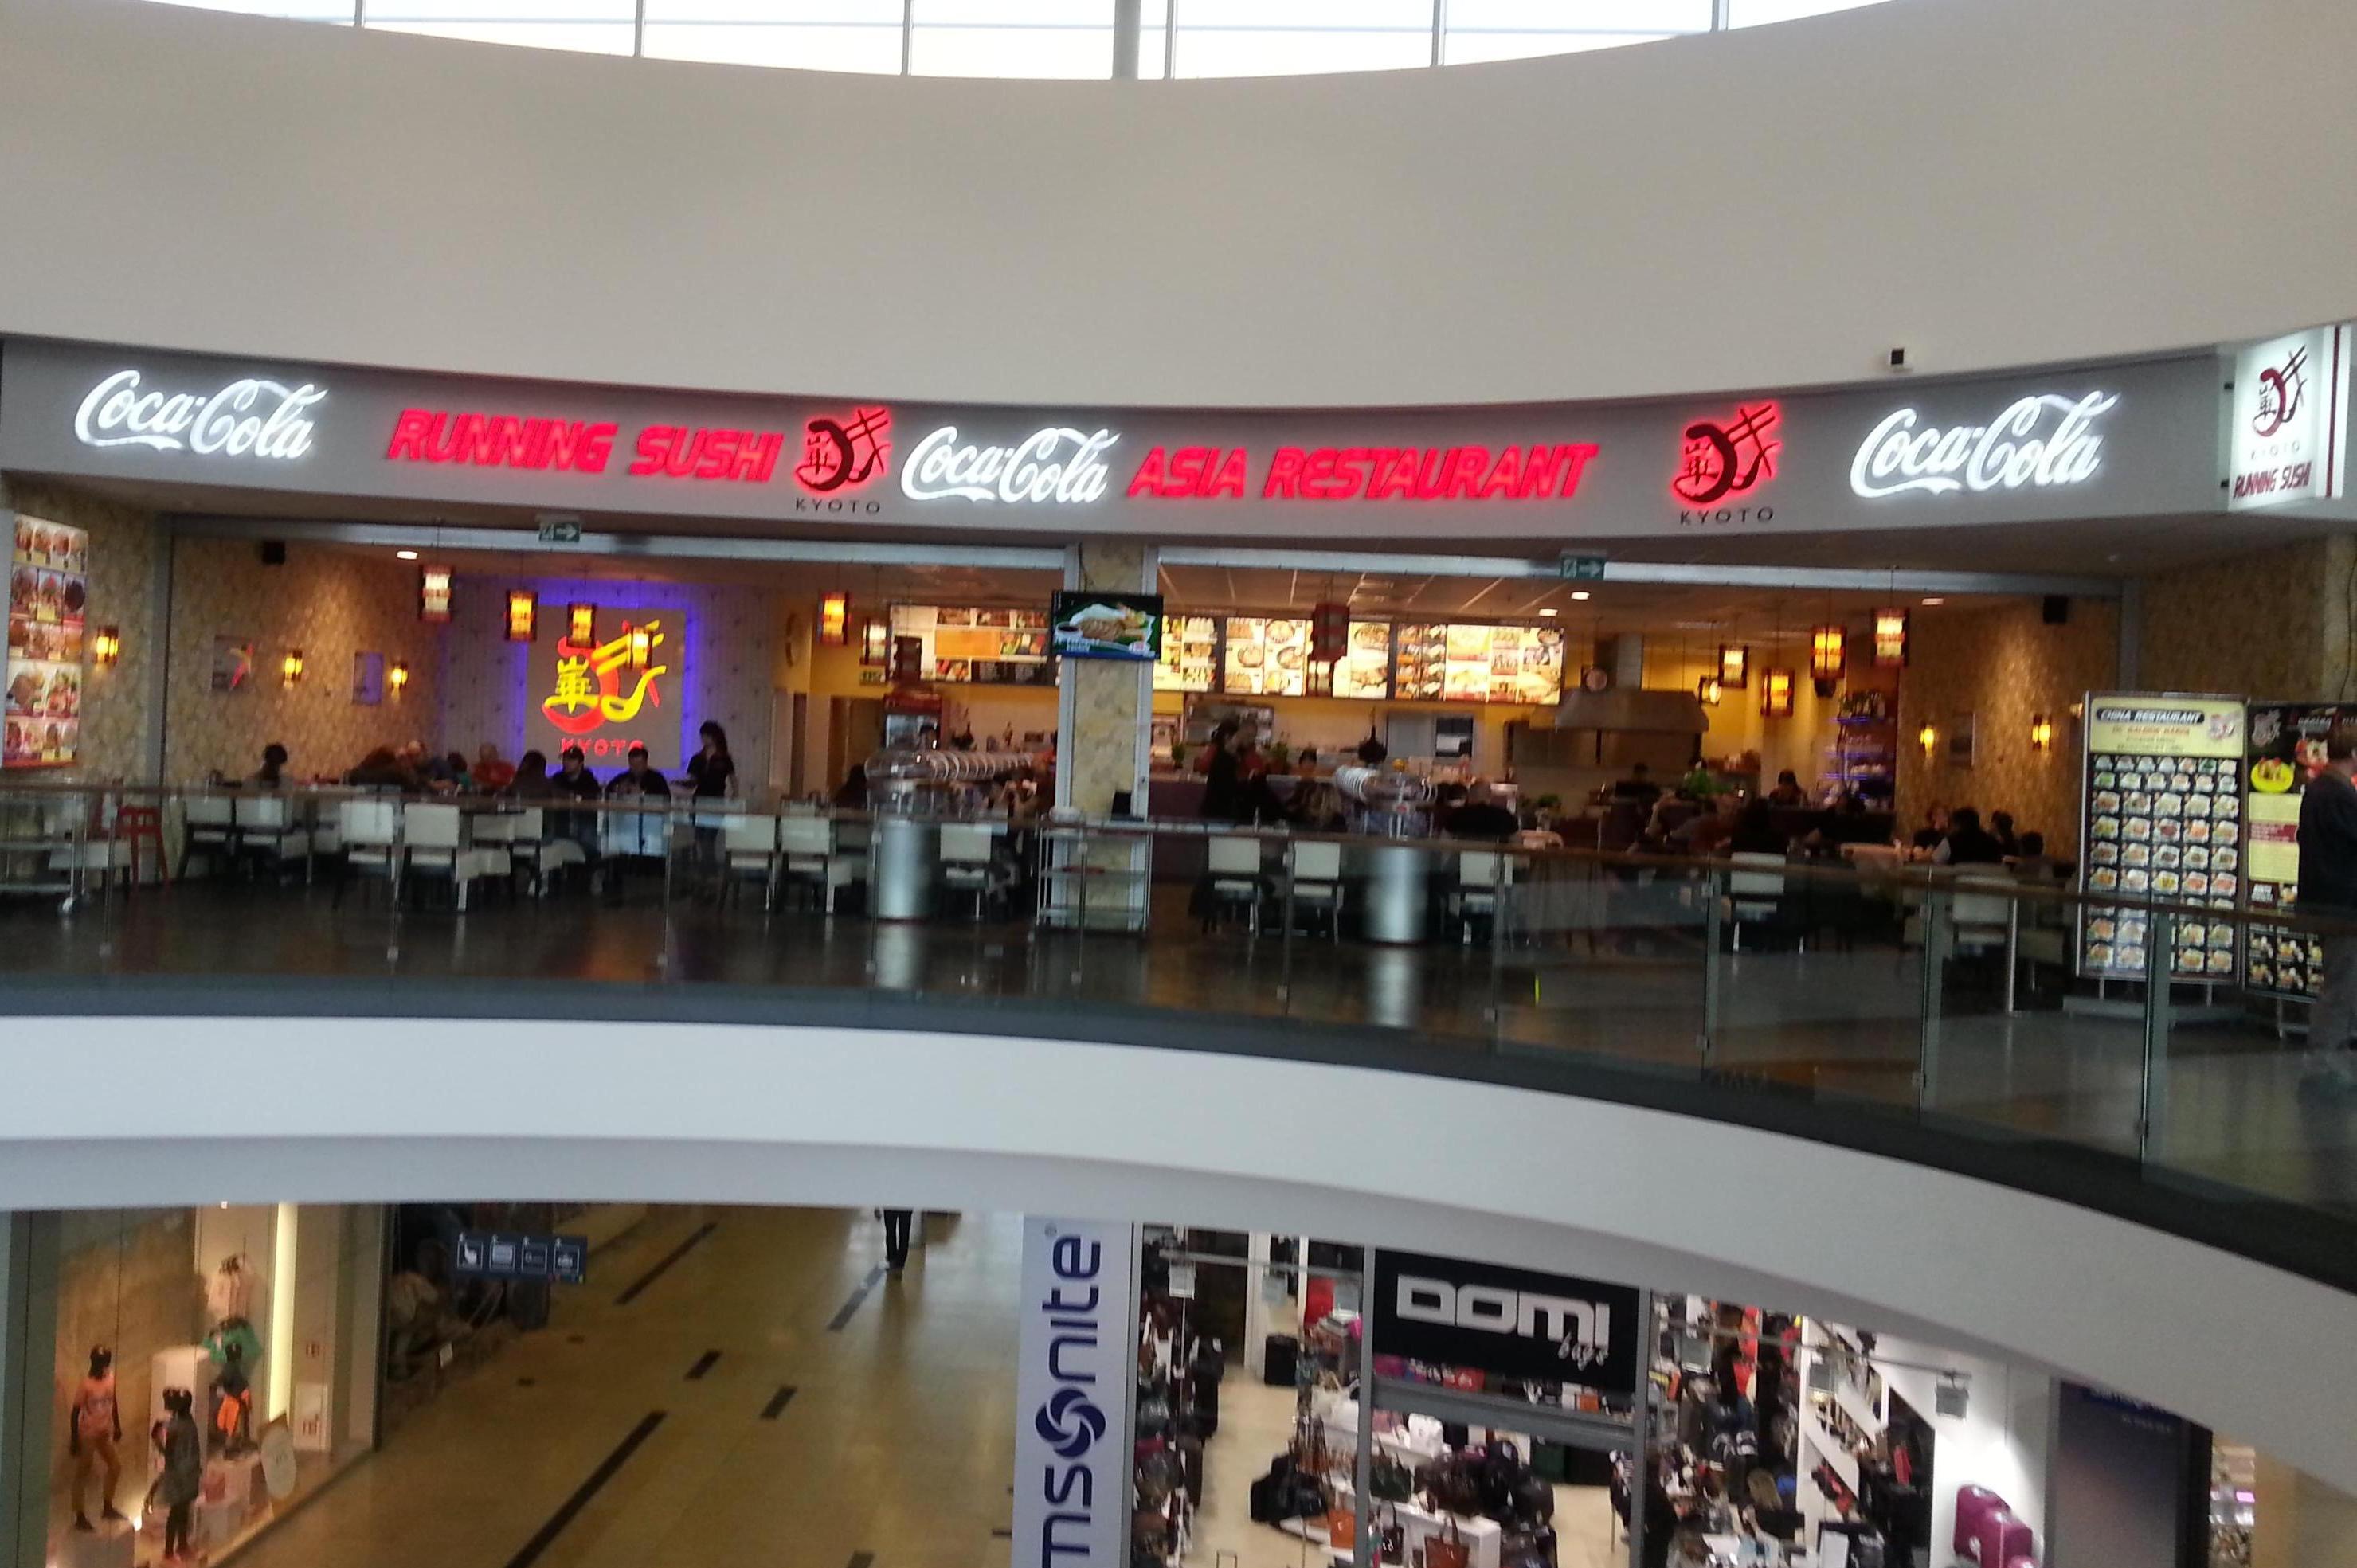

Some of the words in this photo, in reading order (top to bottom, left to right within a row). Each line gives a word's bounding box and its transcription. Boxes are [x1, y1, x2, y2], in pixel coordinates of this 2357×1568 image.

[75, 370, 328, 459] Coca-Cola
[387, 409, 618, 475] RUNNING
[629, 425, 784, 483] SUSHI
[901, 426, 1121, 503] Coca-Cola
[1127, 445, 1247, 499] ASIA
[1263, 444, 1599, 499] RESTAURANT
[1850, 390, 2122, 499] Coca-Cola
[796, 497, 880, 514] KYOTO
[2233, 468, 2279, 499] RUNNING
[2280, 460, 2313, 490] SUSHI
[1679, 506, 1774, 525] KYOTO
[2101, 710, 2132, 721] CHINA
[2134, 710, 2202, 725] RESTAURANT
